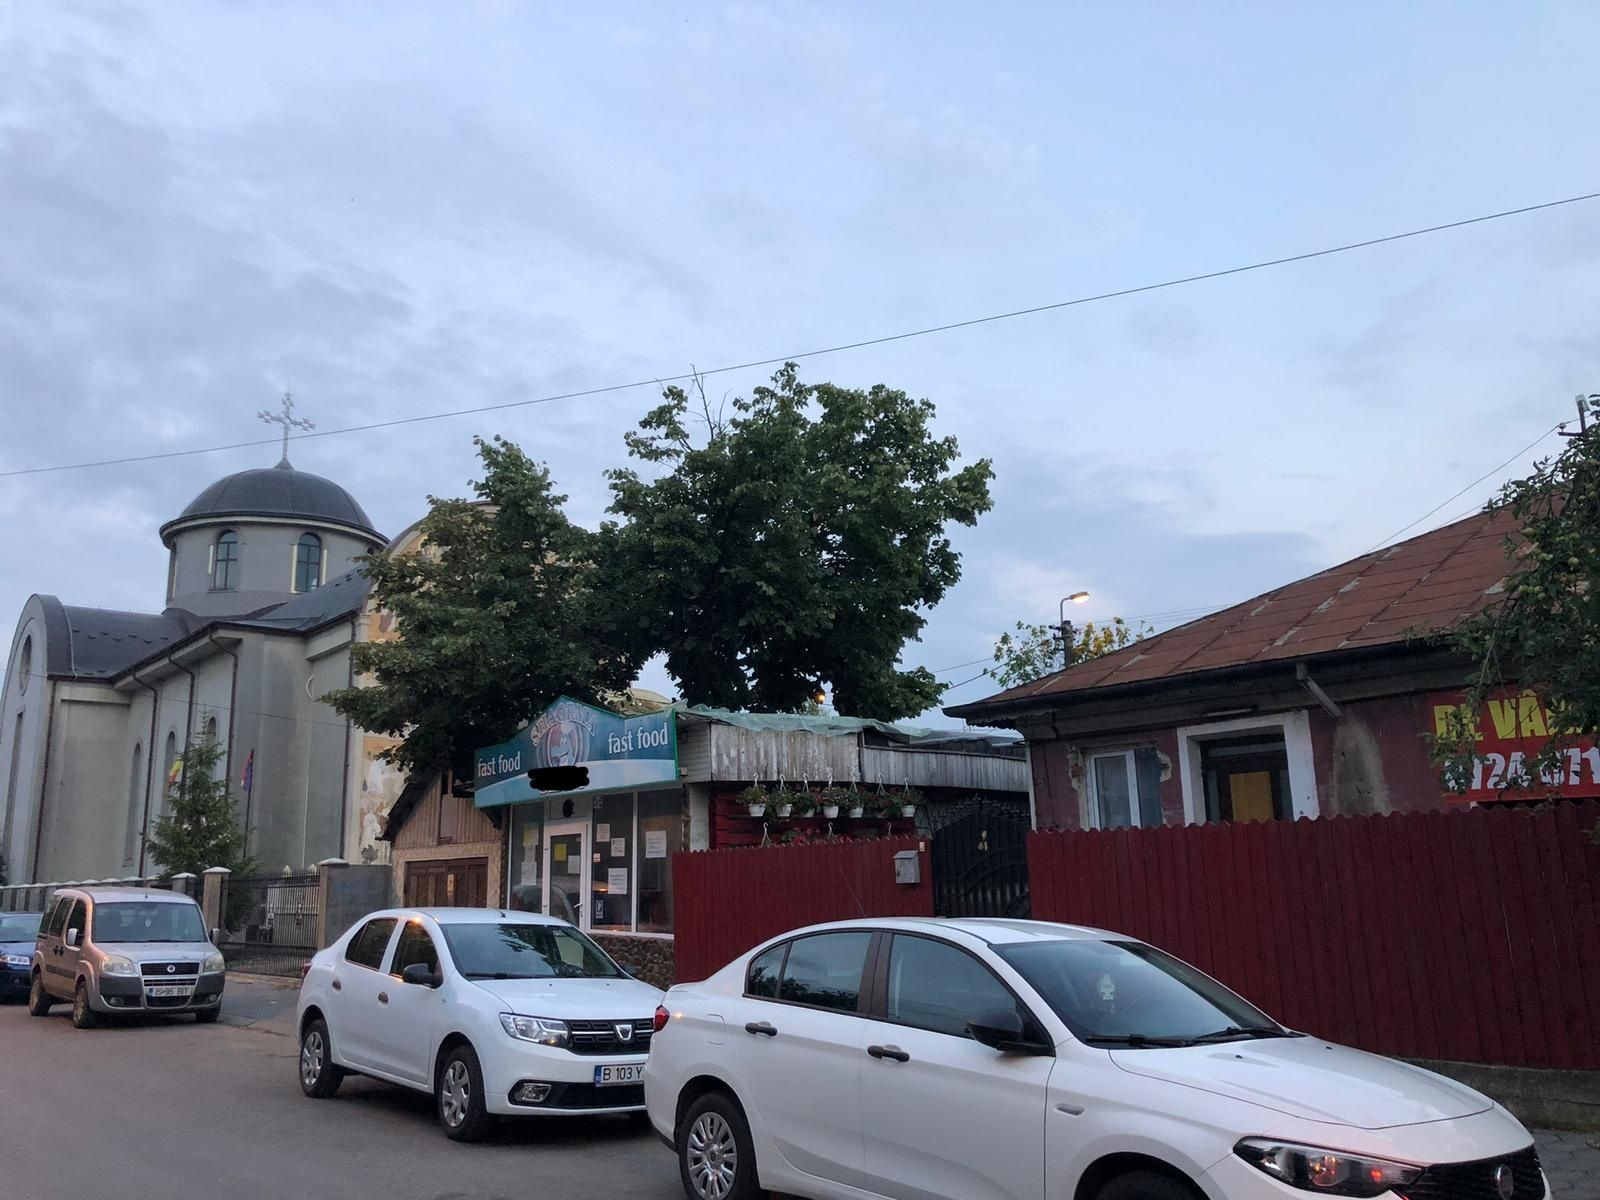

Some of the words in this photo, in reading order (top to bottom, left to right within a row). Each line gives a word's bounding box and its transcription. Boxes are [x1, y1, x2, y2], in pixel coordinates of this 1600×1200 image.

[608, 731, 633, 754] fast
[637, 723, 668, 748] food
[478, 757, 496, 777] fast
[499, 751, 521, 773] food
[603, 1067, 611, 1081] B
[616, 1066, 633, 1080] 103
